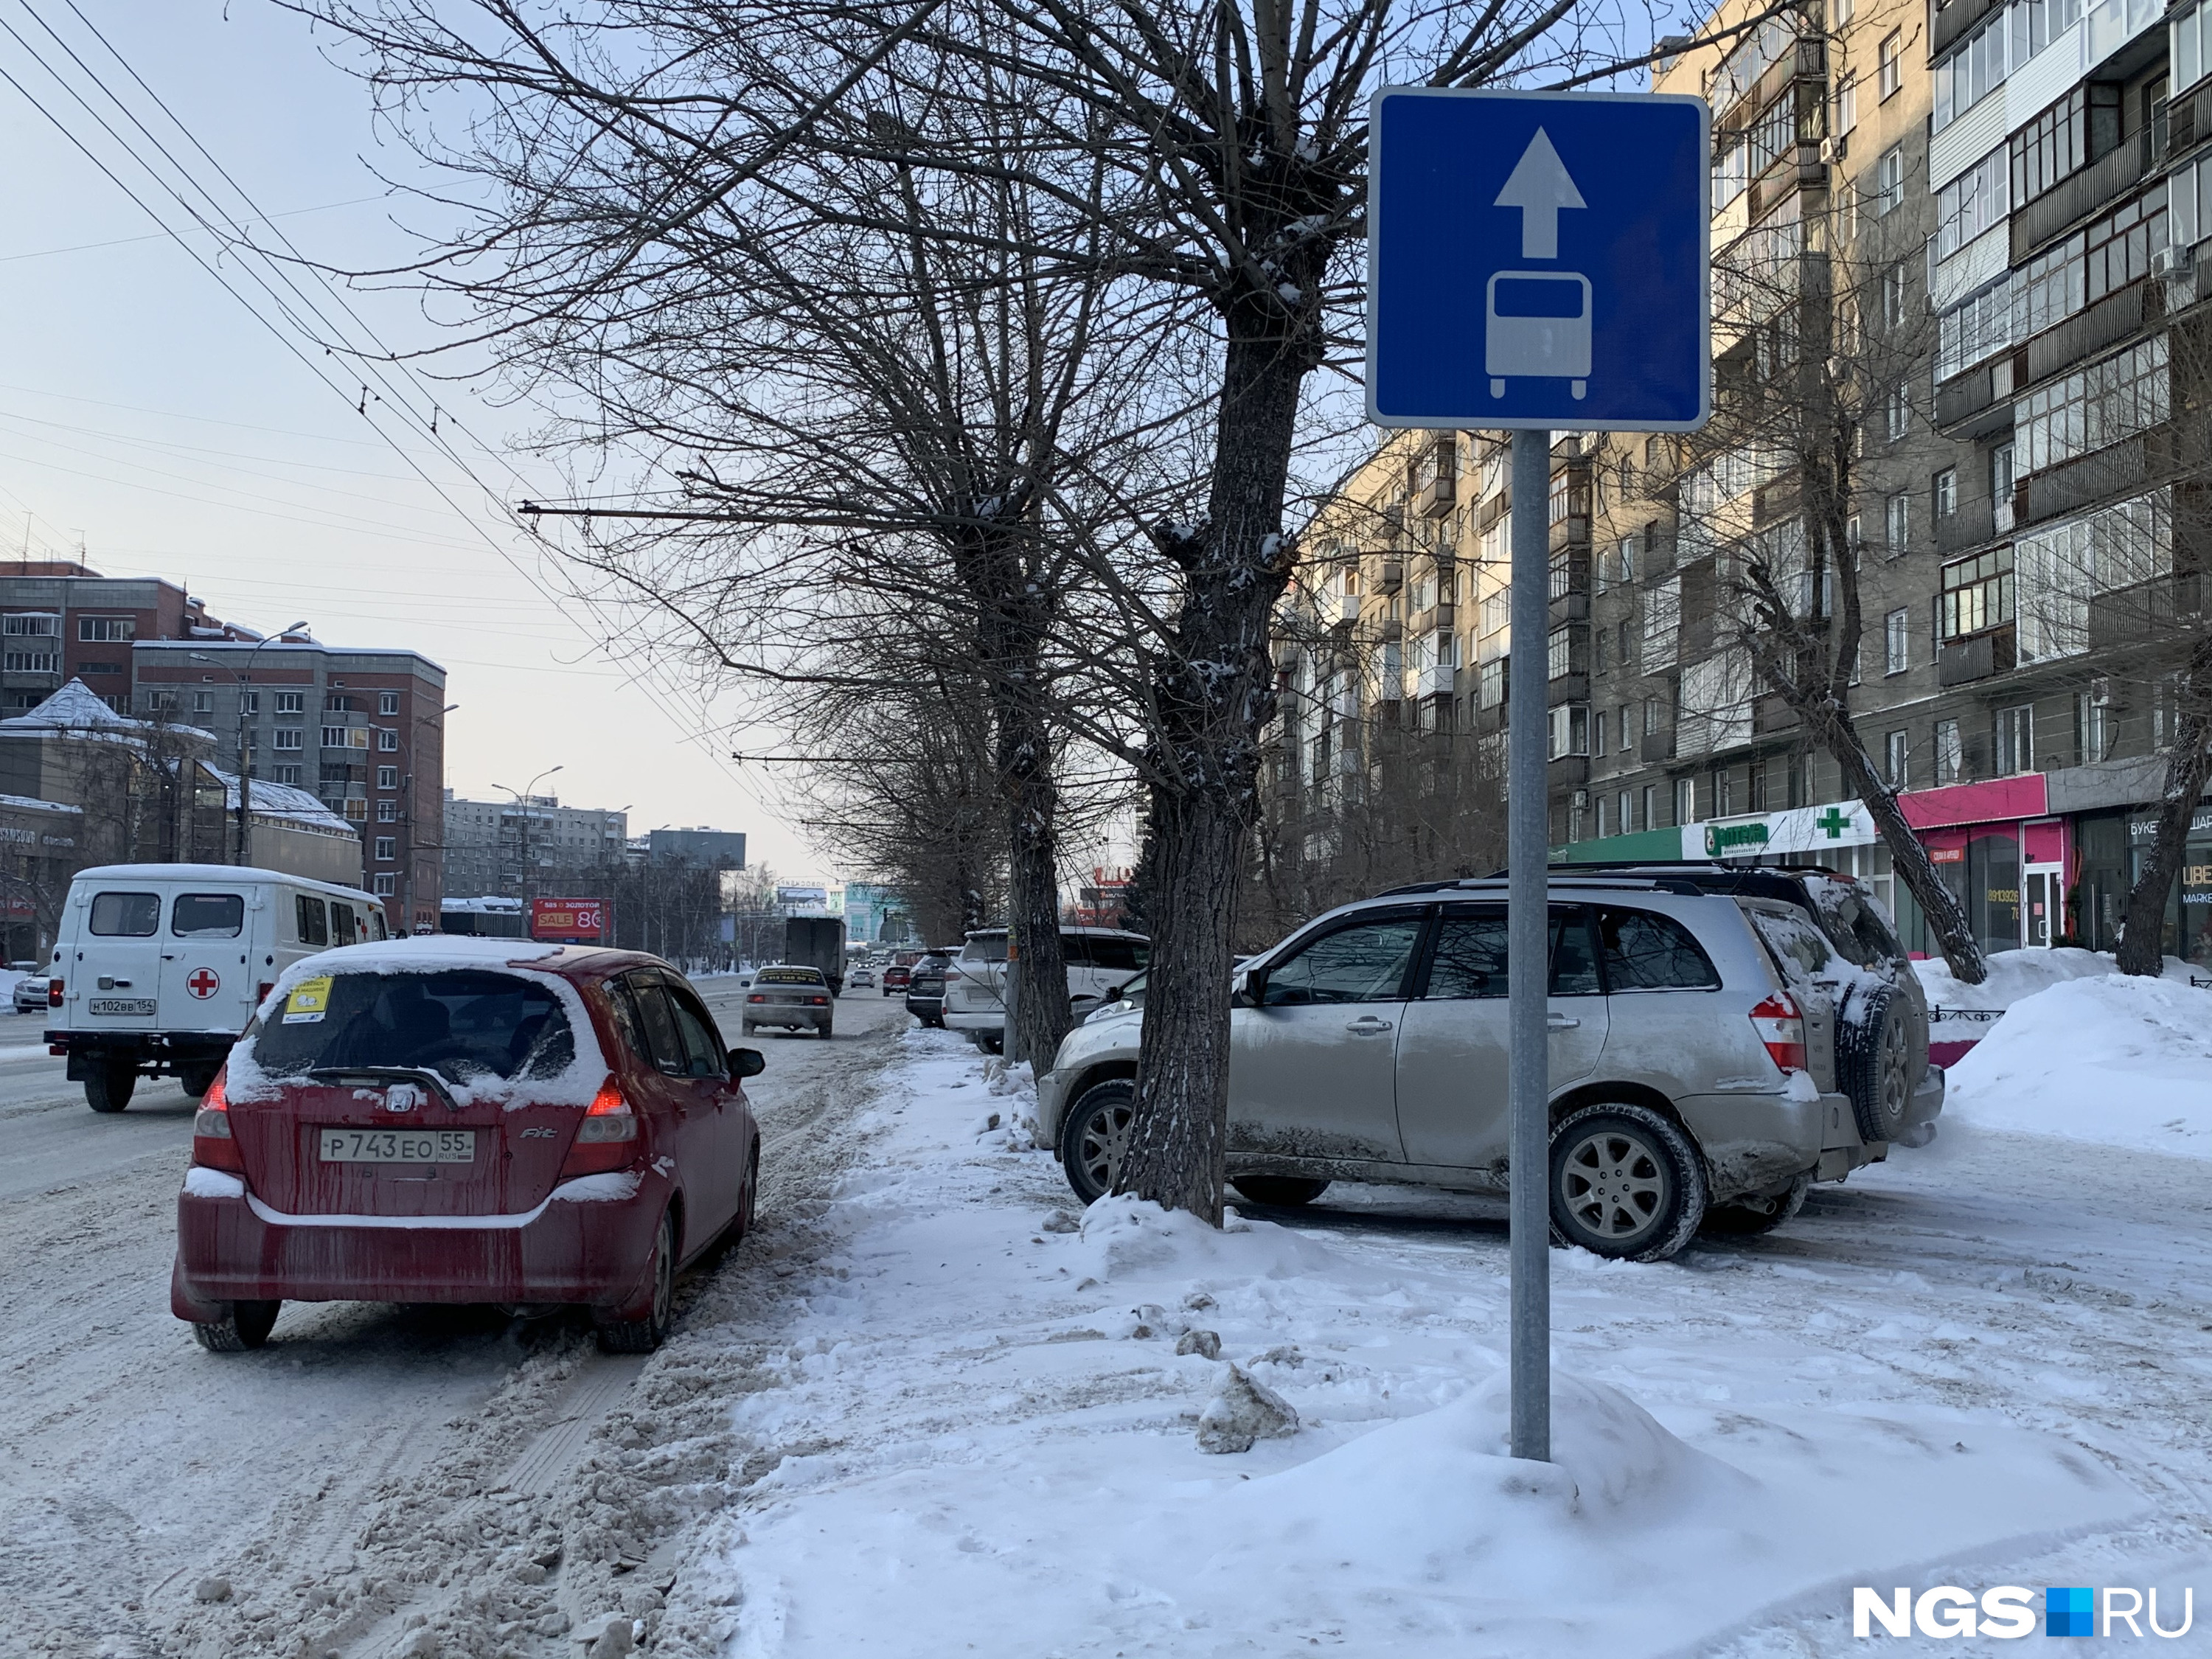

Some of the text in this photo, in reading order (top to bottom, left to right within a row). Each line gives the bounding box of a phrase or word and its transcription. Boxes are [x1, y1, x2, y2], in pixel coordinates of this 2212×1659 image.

[2130, 820, 2159, 835] БУКЕ
[1988, 888, 2019, 902] 8913926
[540, 915, 571, 925] SALE
[137, 1001, 153, 1009] 154
[519, 1126, 558, 1138] Fit
[441, 1133, 465, 1151] 55
